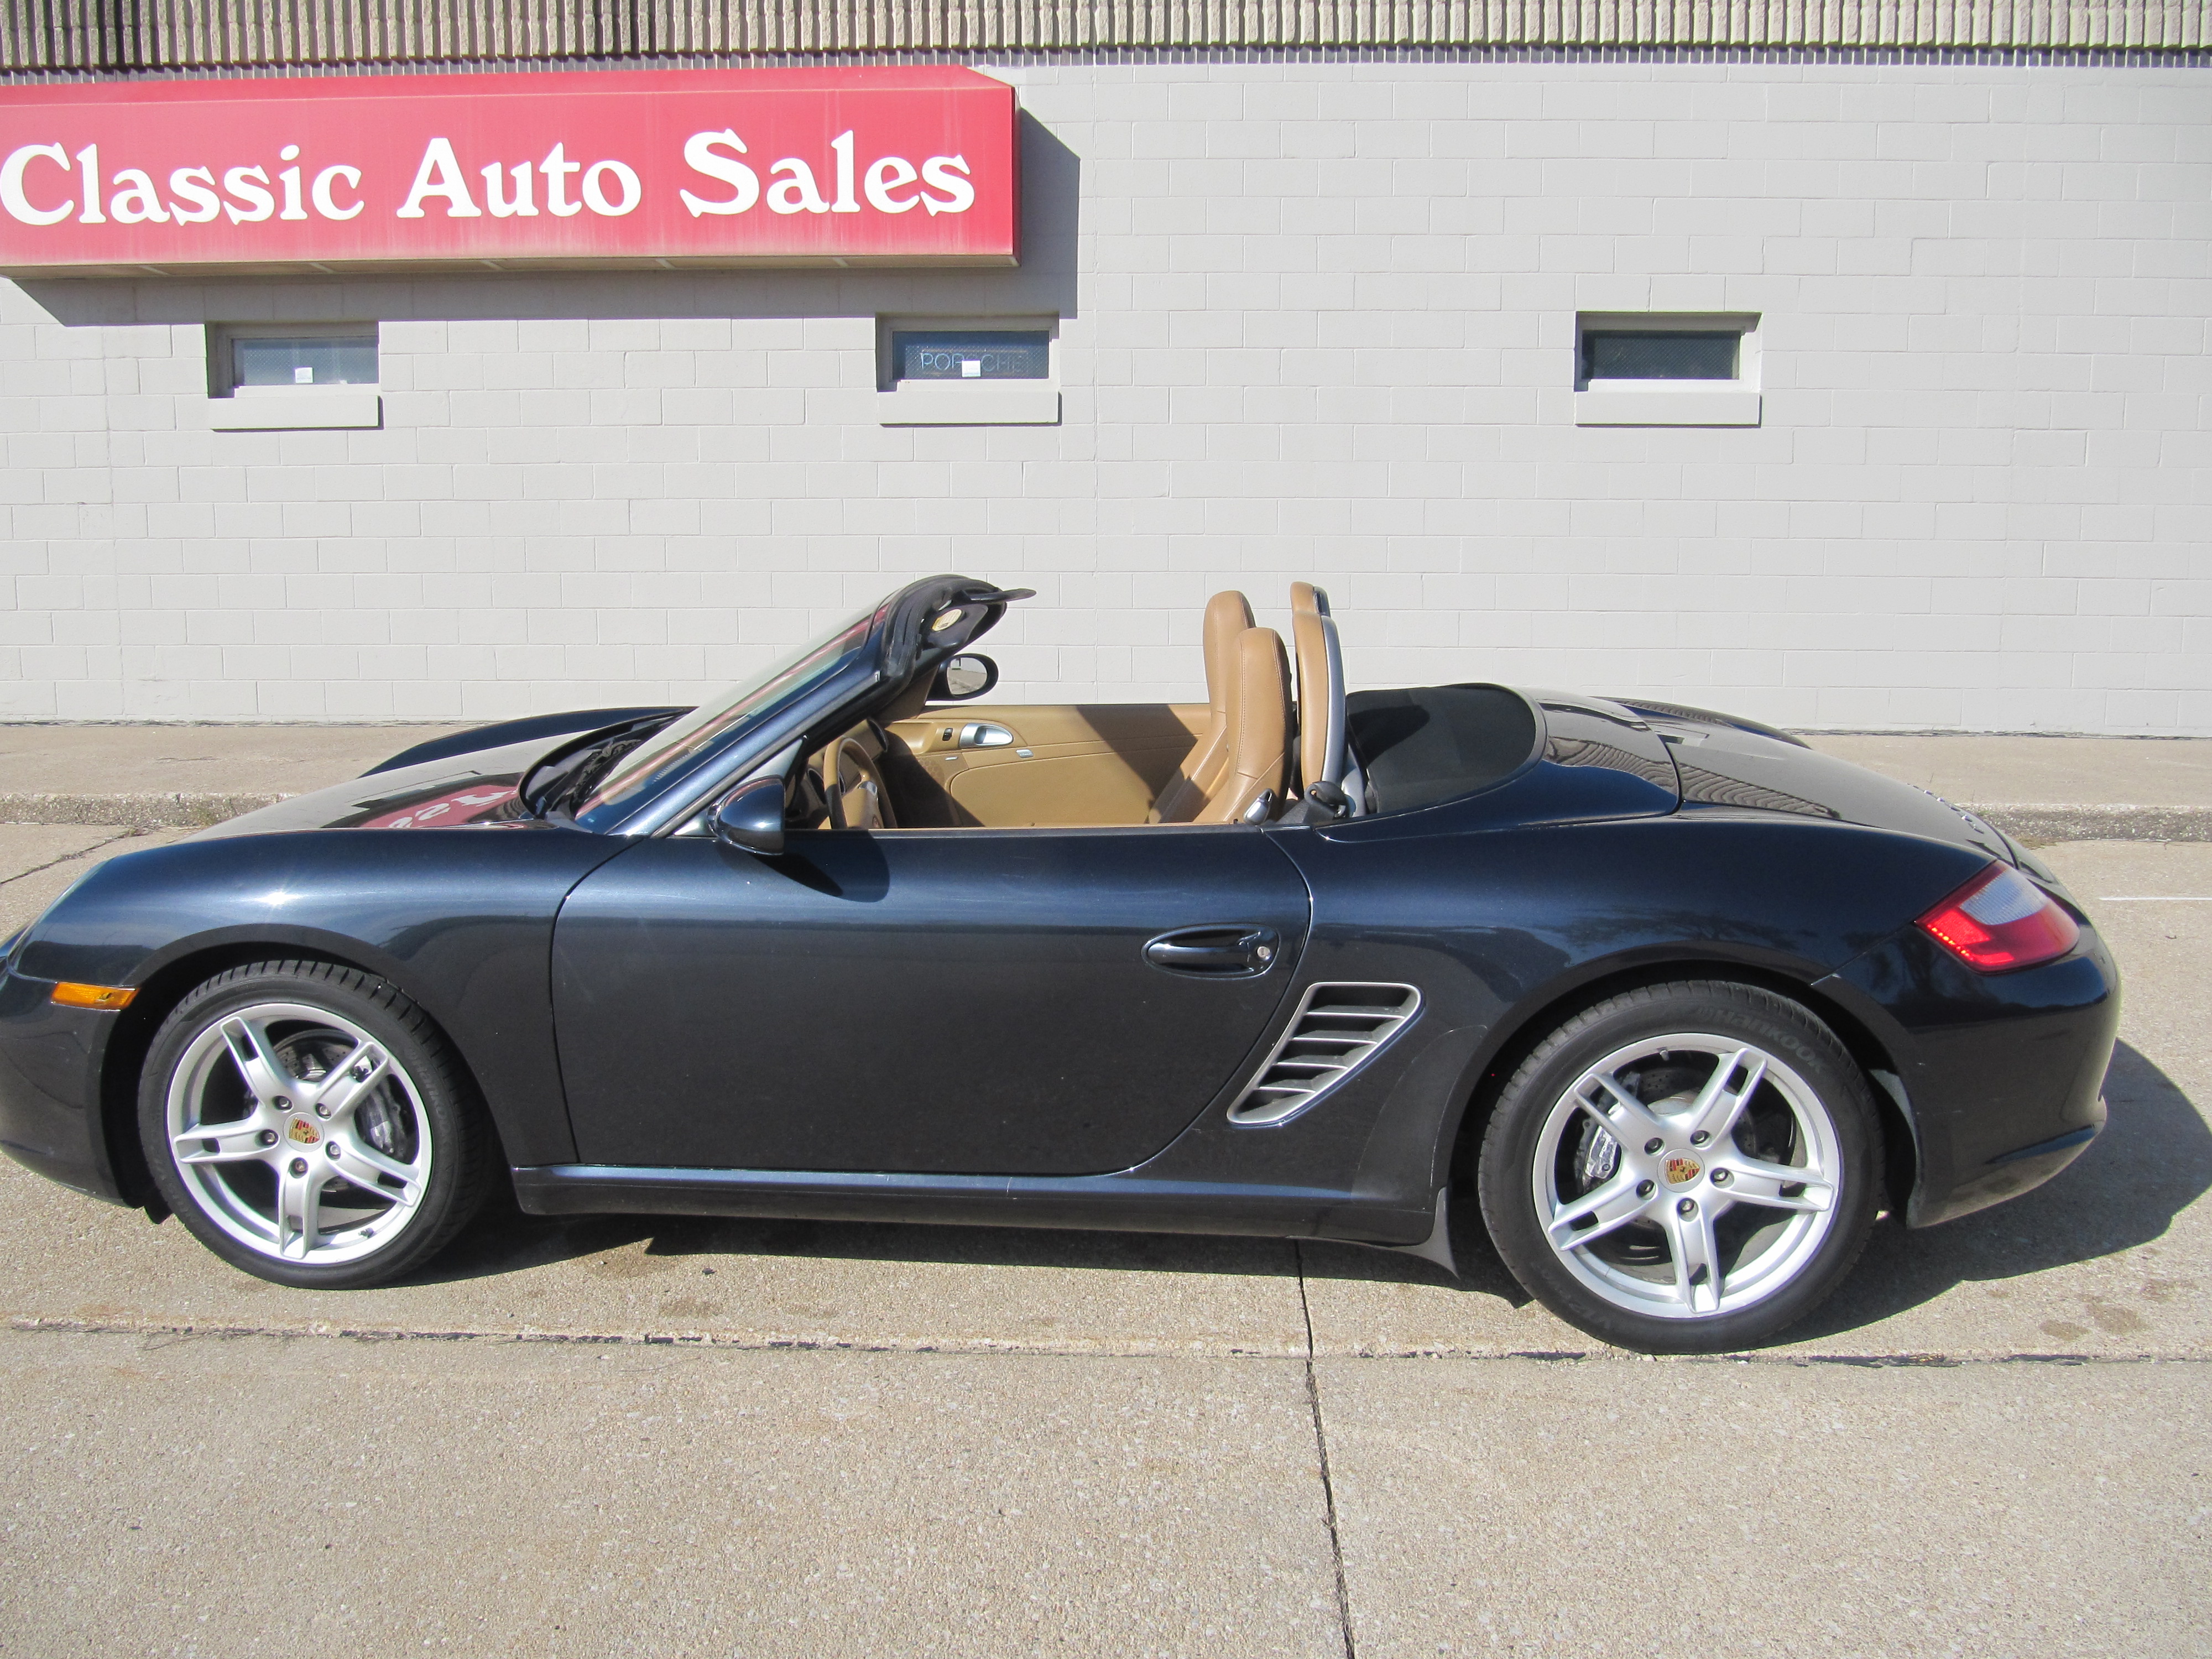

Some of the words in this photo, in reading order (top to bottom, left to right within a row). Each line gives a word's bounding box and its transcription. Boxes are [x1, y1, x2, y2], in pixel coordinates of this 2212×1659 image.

[0, 142, 365, 226] Classic
[397, 138, 641, 218] Auto
[680, 128, 975, 218] Sales
